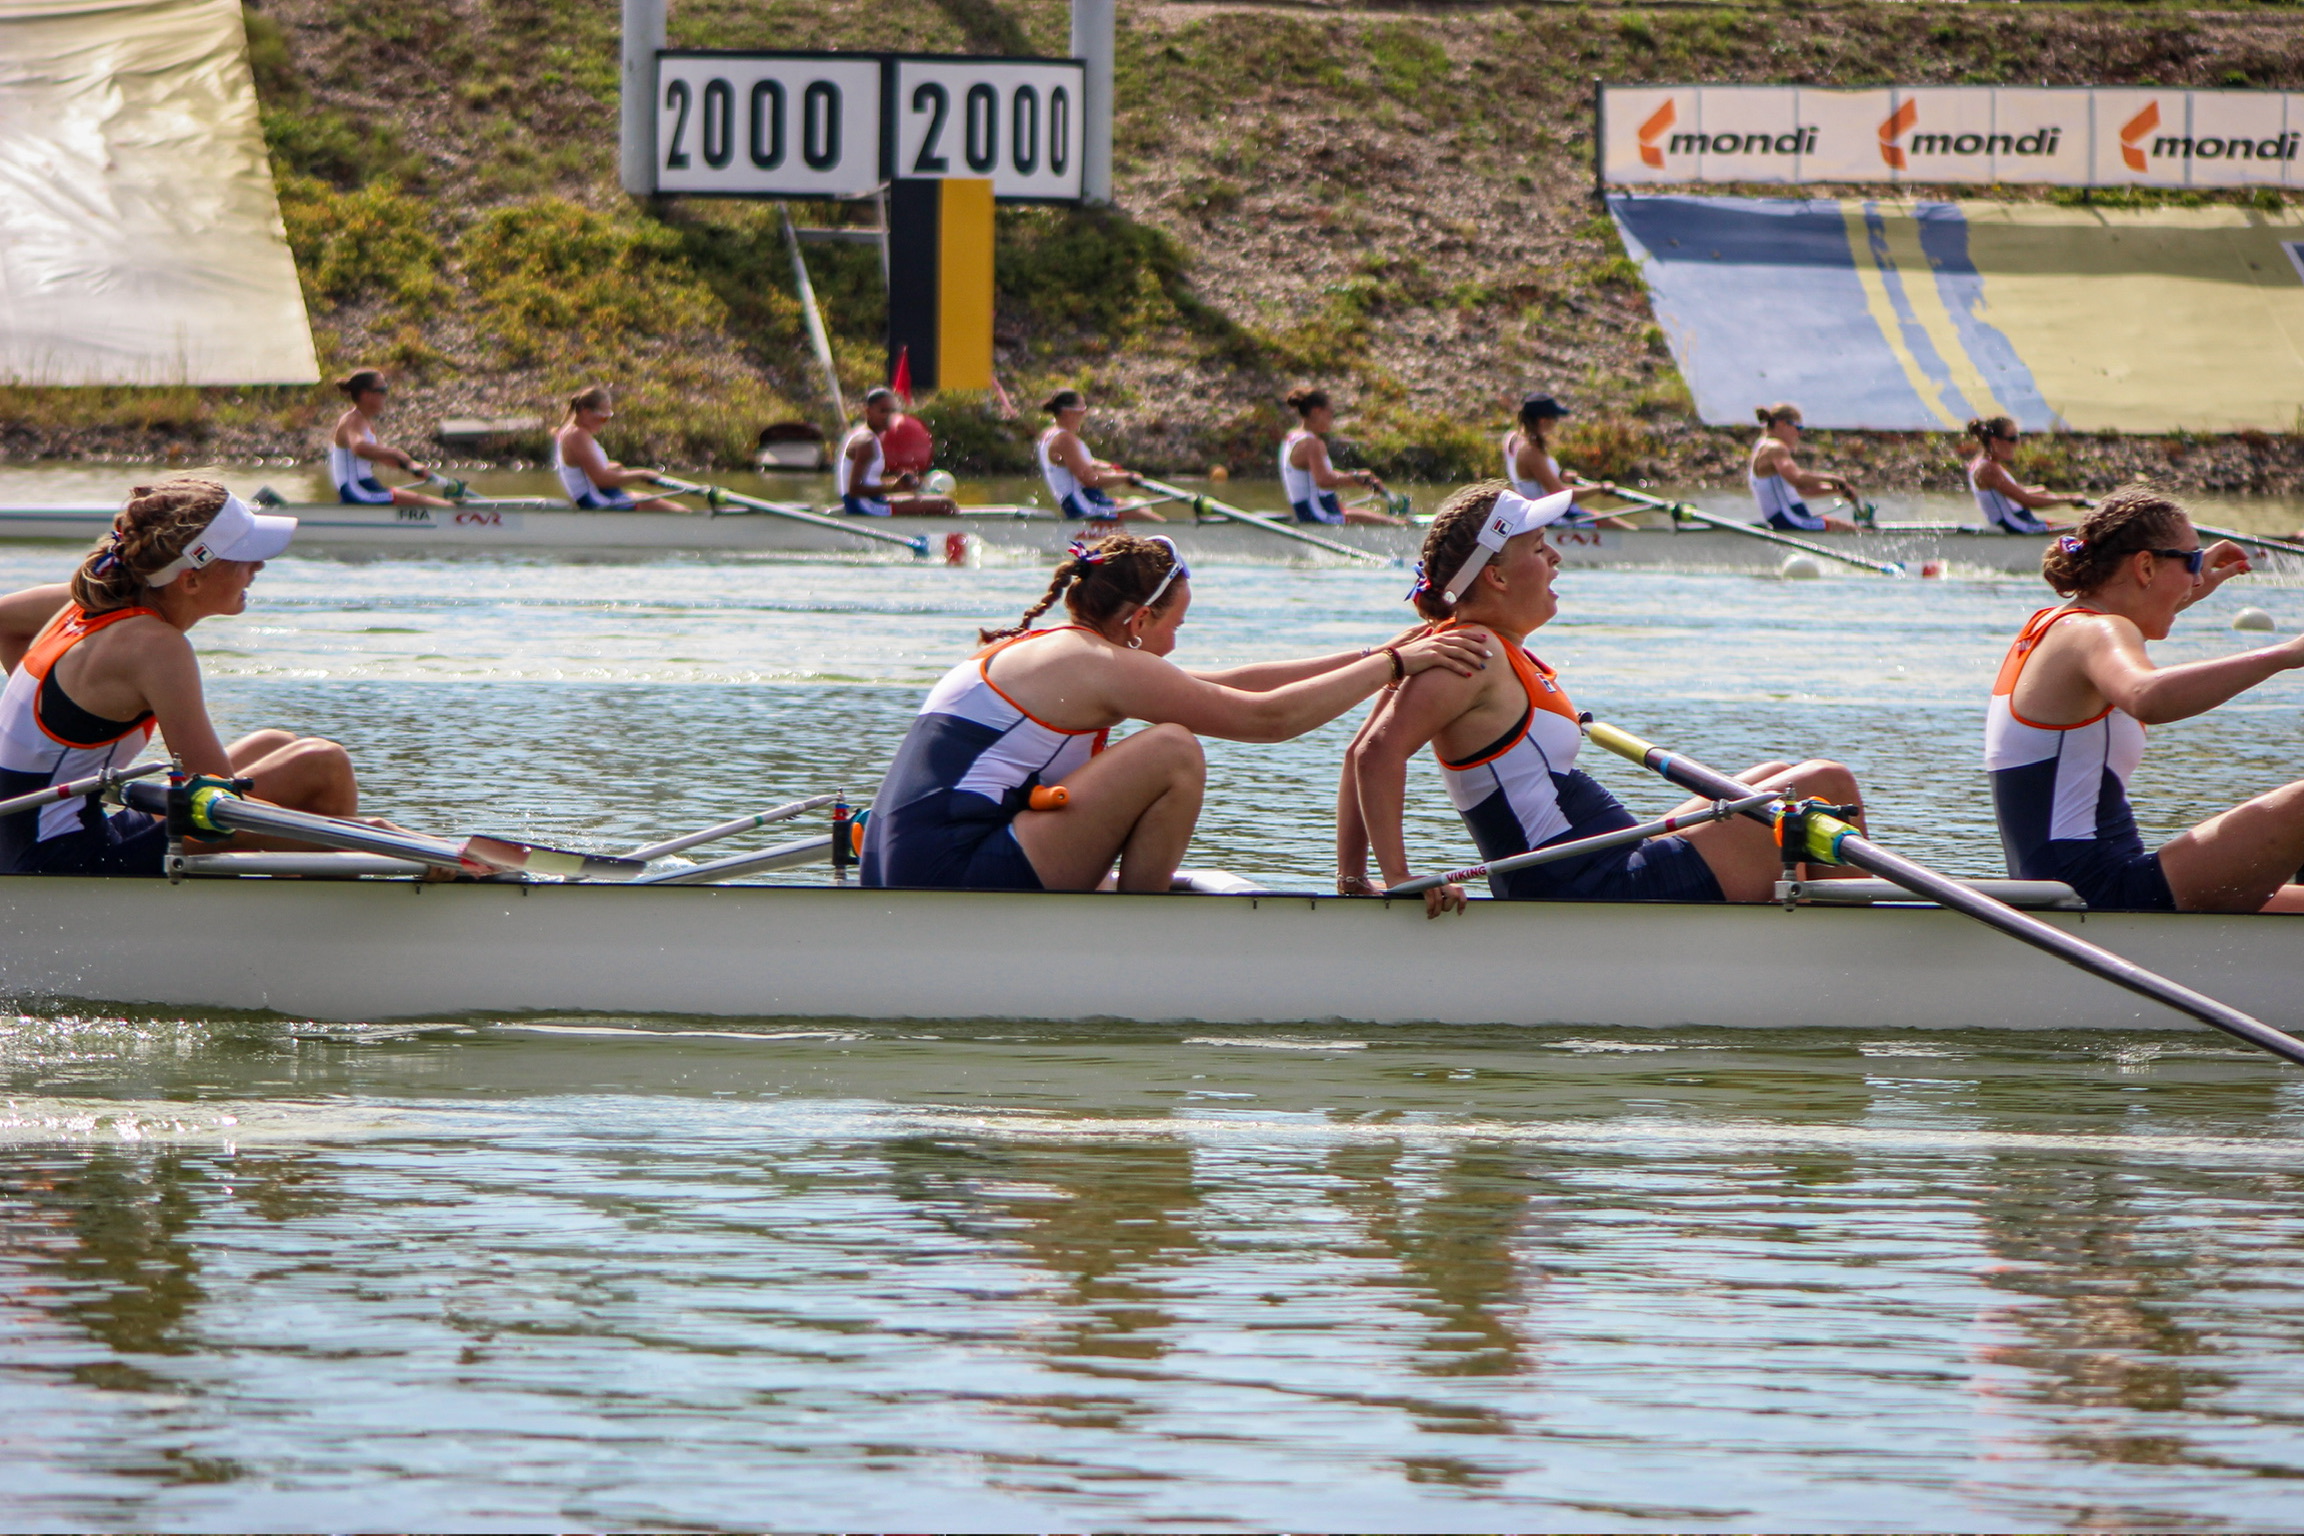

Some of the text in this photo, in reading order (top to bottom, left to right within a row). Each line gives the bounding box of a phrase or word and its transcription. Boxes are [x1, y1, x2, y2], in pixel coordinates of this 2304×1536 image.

[666, 78, 842, 171] 2000
[912, 82, 1068, 176] 2000
[1669, 126, 1820, 155] mondi
[1911, 126, 2062, 156] mondi
[2152, 132, 2302, 160] mondi
[399, 508, 431, 521] FRA
[1446, 866, 1487, 882] VIKING
